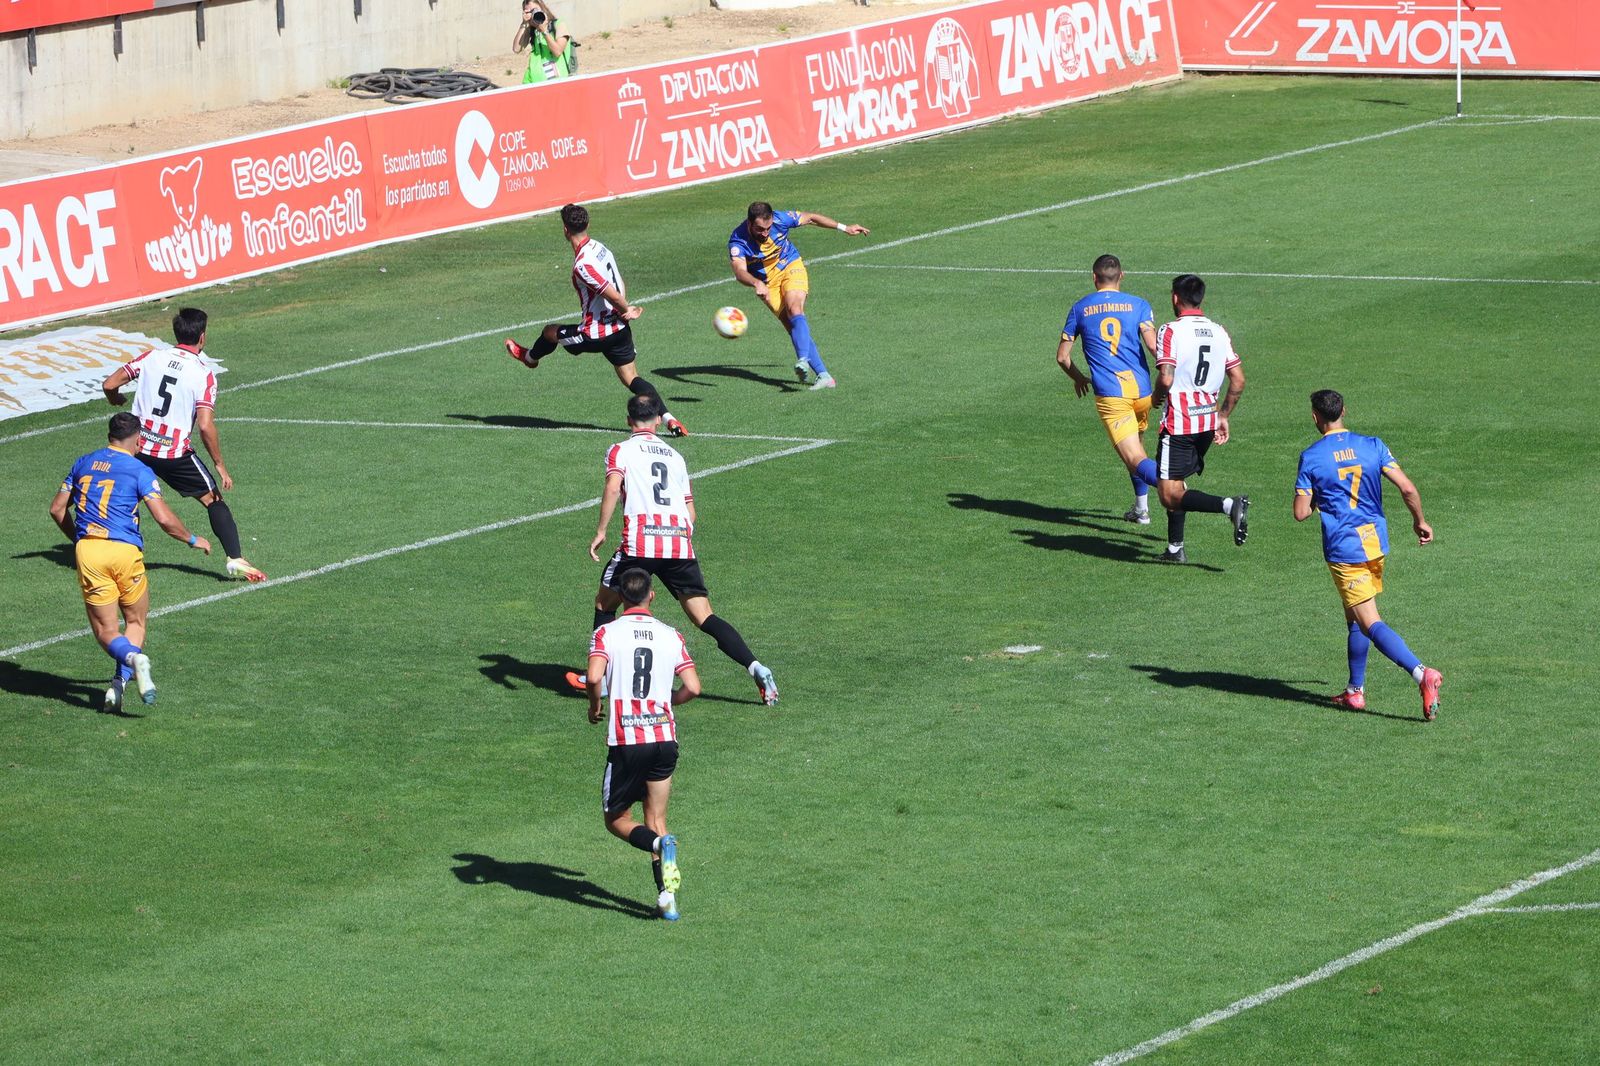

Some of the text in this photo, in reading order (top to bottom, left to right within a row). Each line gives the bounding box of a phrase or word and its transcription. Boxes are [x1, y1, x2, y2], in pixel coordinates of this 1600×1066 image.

[805, 28, 916, 95] FUNDACIÓN
[990, 0, 1162, 96] ZAMORA CF
[1295, 17, 1517, 65] ZAMORA
[383, 145, 447, 174] Escucha todos
[499, 130, 526, 153] COPE
[551, 137, 588, 159] COPE.es
[660, 114, 779, 179] ZAMORA
[231, 136, 363, 200] Escuela
[502, 151, 549, 177] ZAMORA
[385, 179, 450, 209] los partidos en
[56, 188, 117, 288] CF
[241, 188, 367, 257] infantil
[1100, 317, 1121, 356] 9
[1194, 345, 1210, 387] 6
[152, 374, 177, 417] 5
[648, 446, 673, 457] LUENGO
[78, 474, 115, 519] 11
[651, 462, 671, 506] 2
[1337, 465, 1362, 510] 7
[643, 525, 688, 537] leomotor.net
[633, 647, 653, 699] 8
[621, 714, 670, 726] leomotor.net
